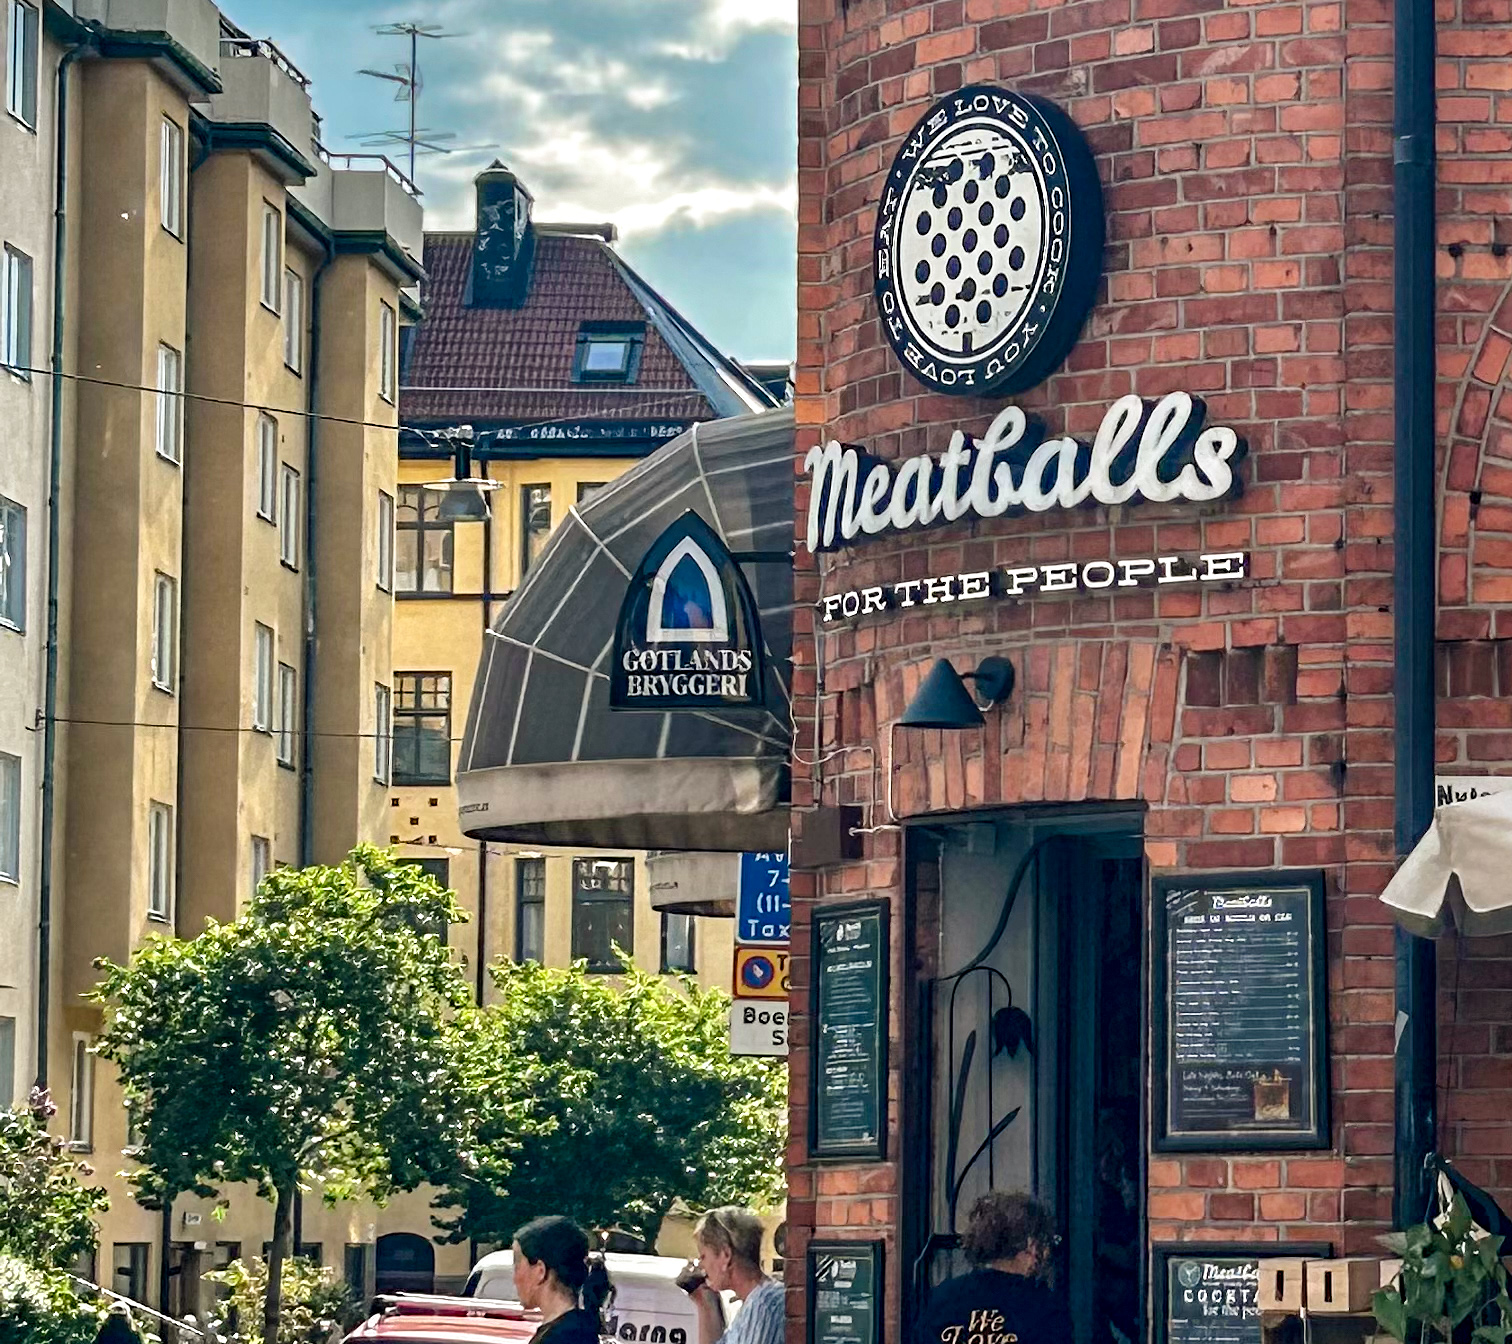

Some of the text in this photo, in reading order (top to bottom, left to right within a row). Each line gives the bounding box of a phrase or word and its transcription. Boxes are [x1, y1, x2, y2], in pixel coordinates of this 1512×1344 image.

[901, 94, 1066, 296] WE LOVE TO COOK
[878, 186, 1038, 387] YOU LOVE TO EAT
[804, 390, 1240, 554] Meatballs
[821, 551, 1247, 623] FOR THE PEOPLE
[622, 649, 752, 672] GOTLANDS
[627, 673, 748, 697] BRYGGERI
[743, 1007, 788, 1025] Boe
[968, 1309, 1005, 1332] We
